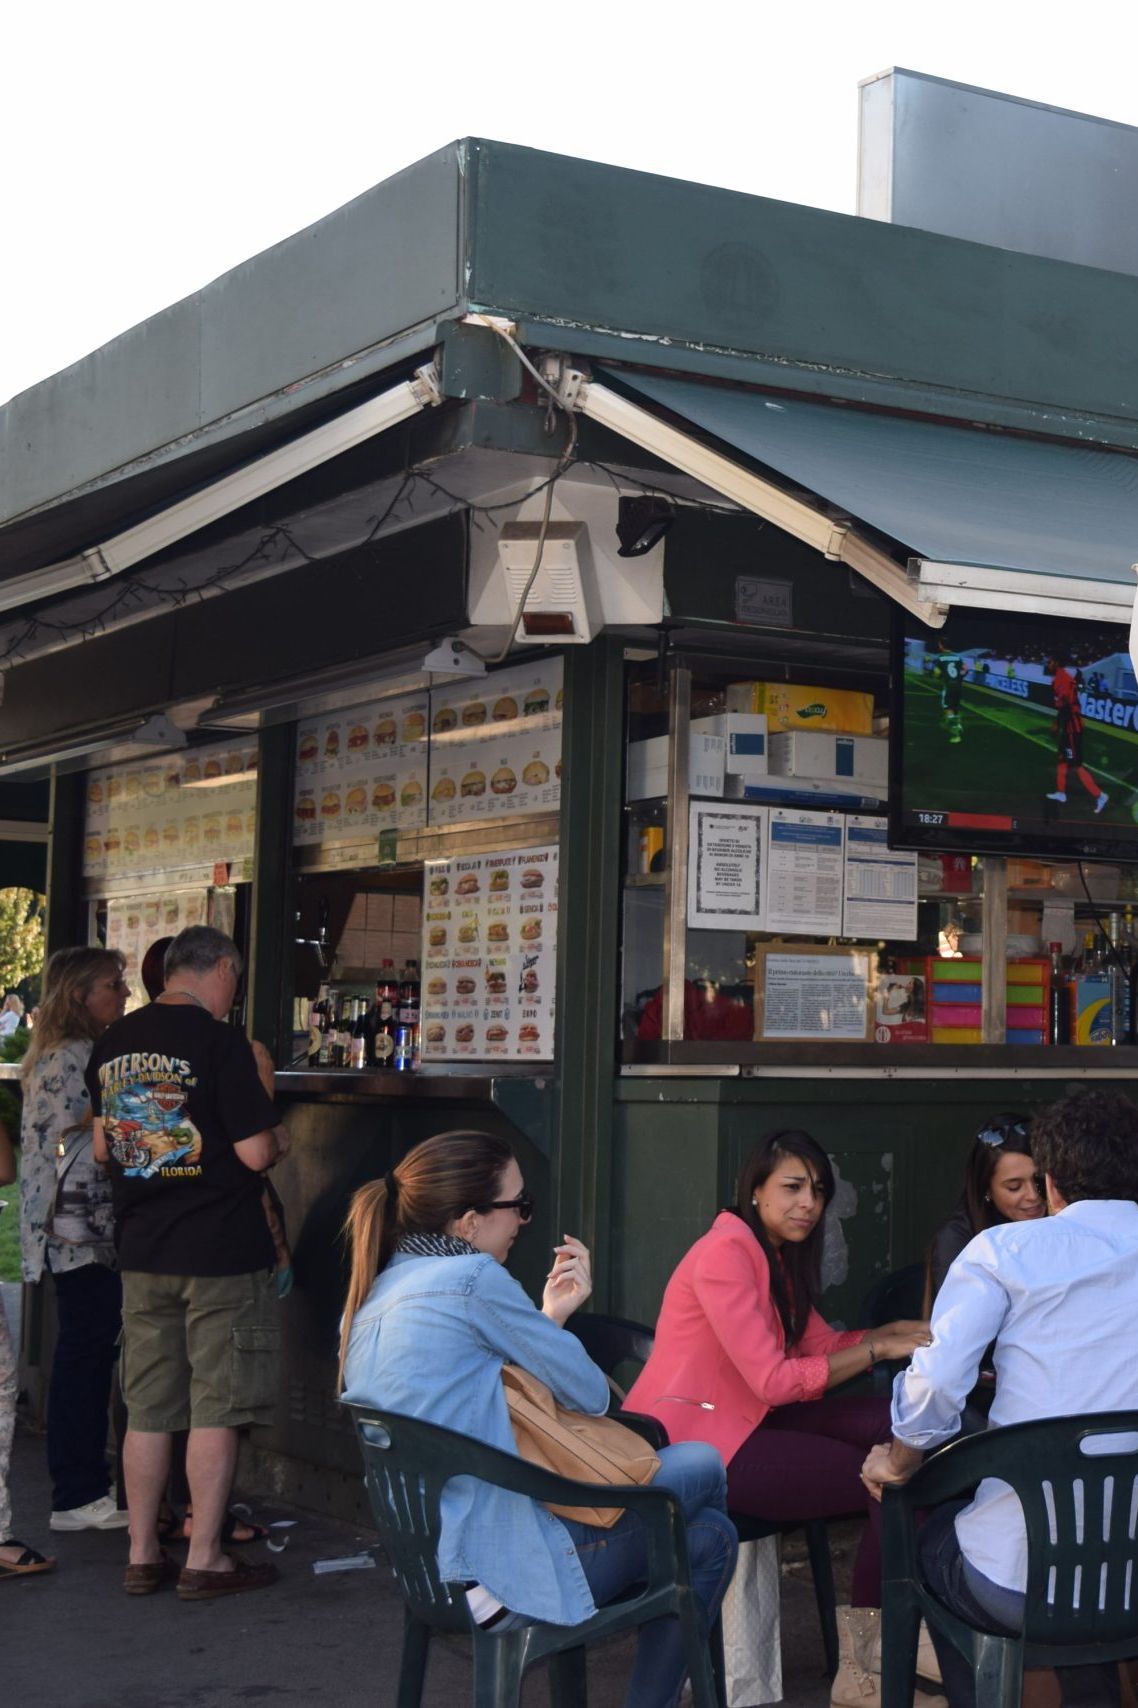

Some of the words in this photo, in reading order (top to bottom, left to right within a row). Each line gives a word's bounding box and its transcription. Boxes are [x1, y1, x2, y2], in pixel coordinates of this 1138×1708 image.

[918, 813, 943, 824] 18:27
[98, 1052, 192, 1087] PETERSON'S
[161, 1165, 203, 1177] FLORIDA
